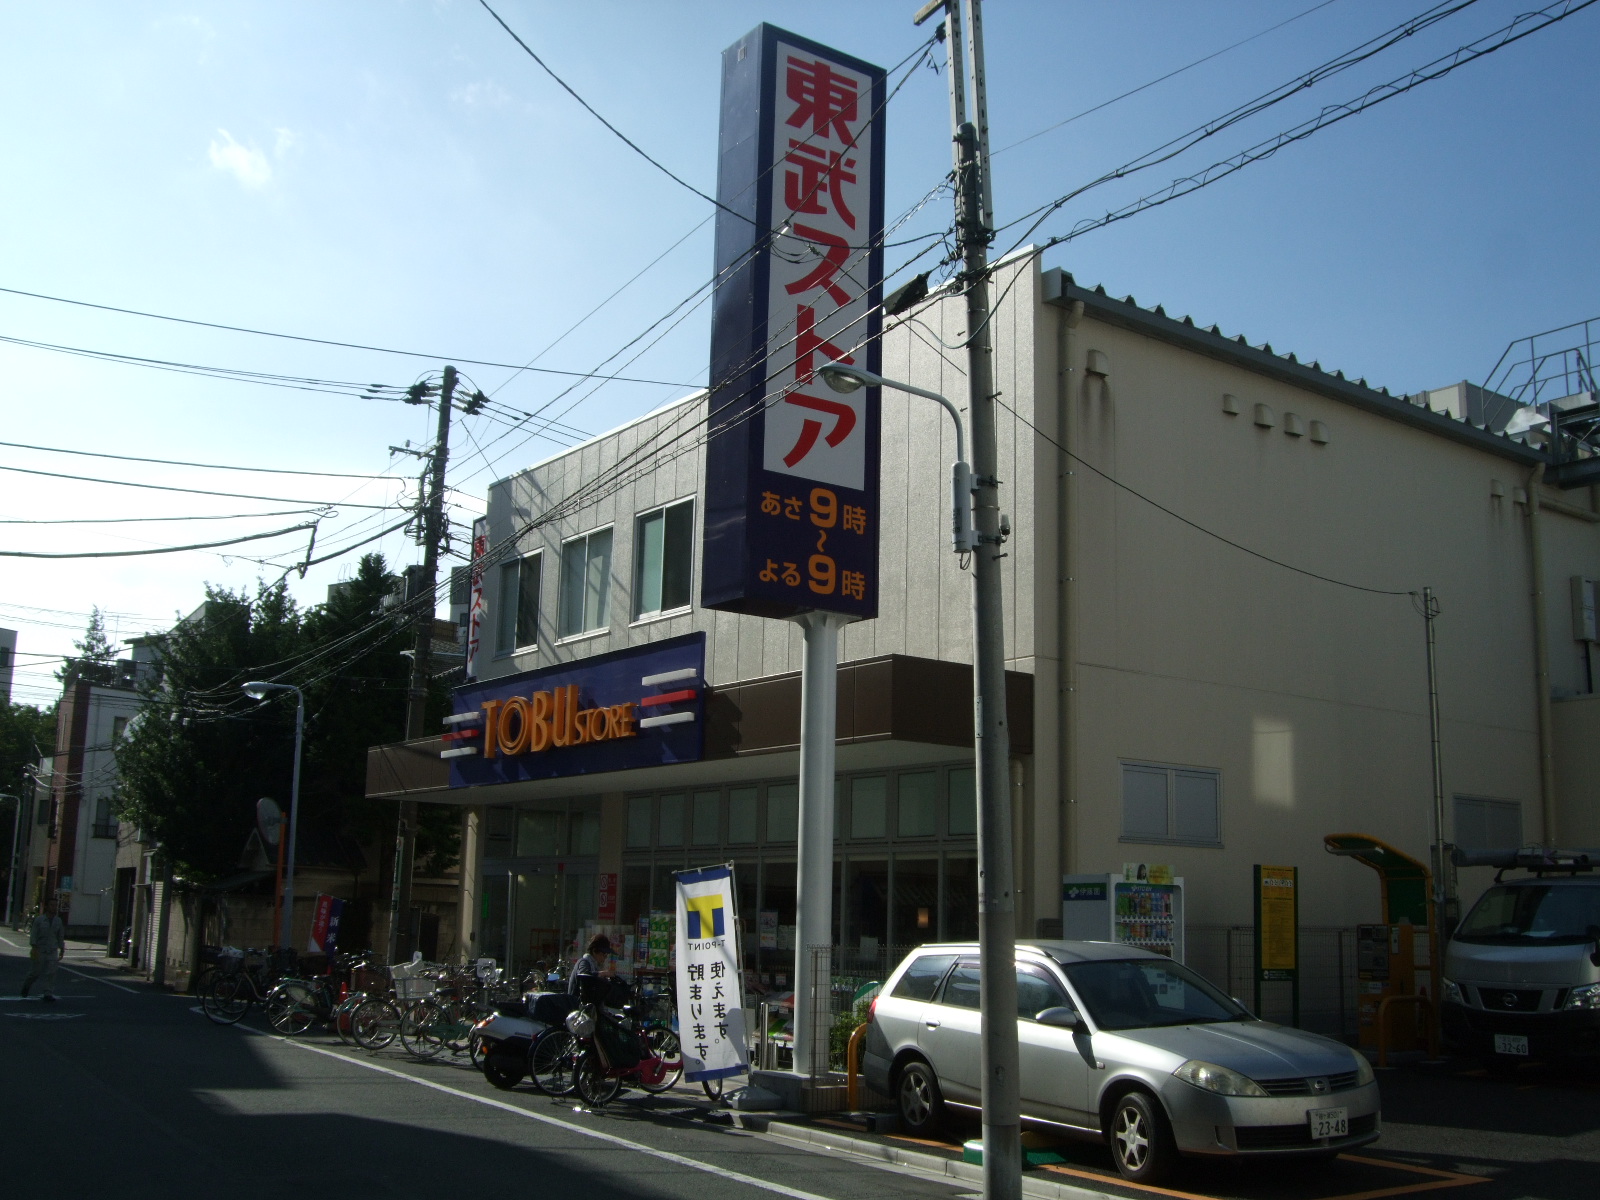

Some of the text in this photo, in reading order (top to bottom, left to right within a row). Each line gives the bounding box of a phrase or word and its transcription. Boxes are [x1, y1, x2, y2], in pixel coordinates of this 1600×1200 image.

[783, 55, 859, 468] 東武ストア
[760, 487, 867, 535] あさ9時
[759, 554, 866, 600] よる9時
[481, 684, 639, 759] TOBU STORE
[1319, 1119, 1346, 1136] 23-48
